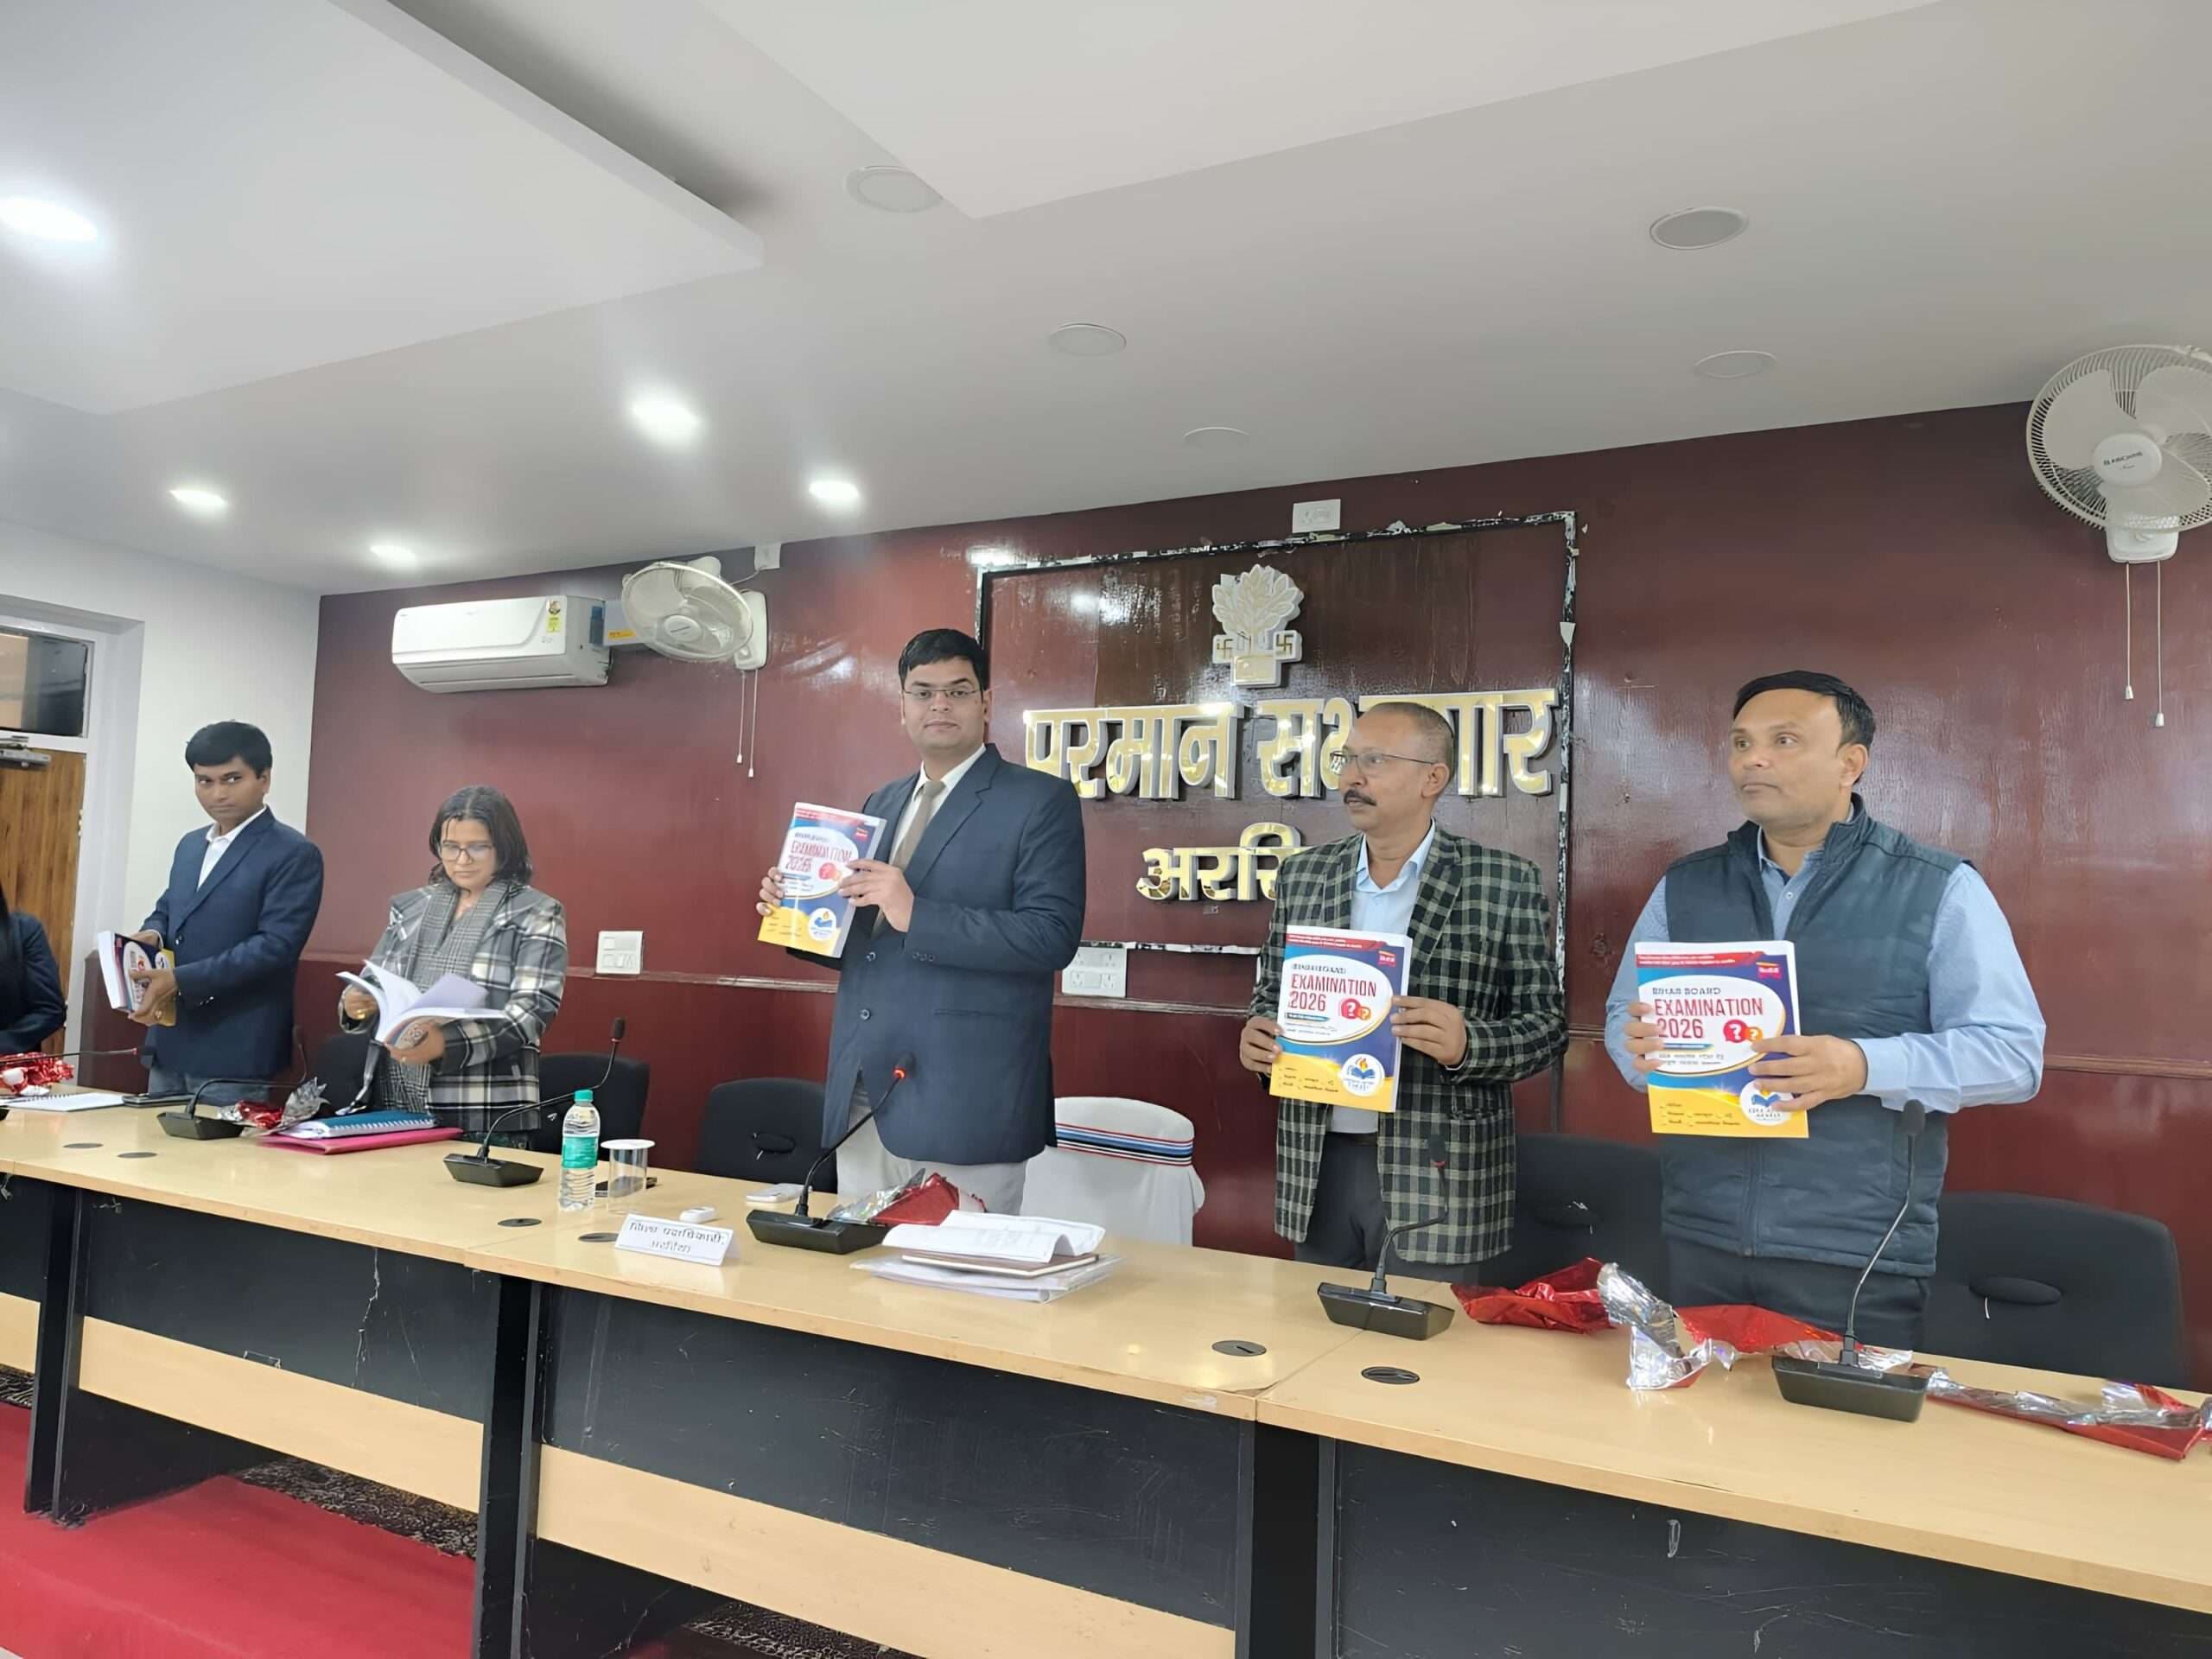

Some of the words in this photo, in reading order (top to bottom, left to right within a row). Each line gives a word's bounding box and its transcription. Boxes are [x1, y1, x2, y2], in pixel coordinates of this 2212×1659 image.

[1023, 702, 1244, 800] परमान
[1255, 689, 1559, 798] सभगार
[1136, 822, 1313, 901] अररि
[1291, 974, 1376, 997] EXAMINATION
[1288, 991, 1327, 1011] 2026
[1654, 997, 1763, 1016] EXAMINATION
[1656, 1018, 1704, 1038] 2026
